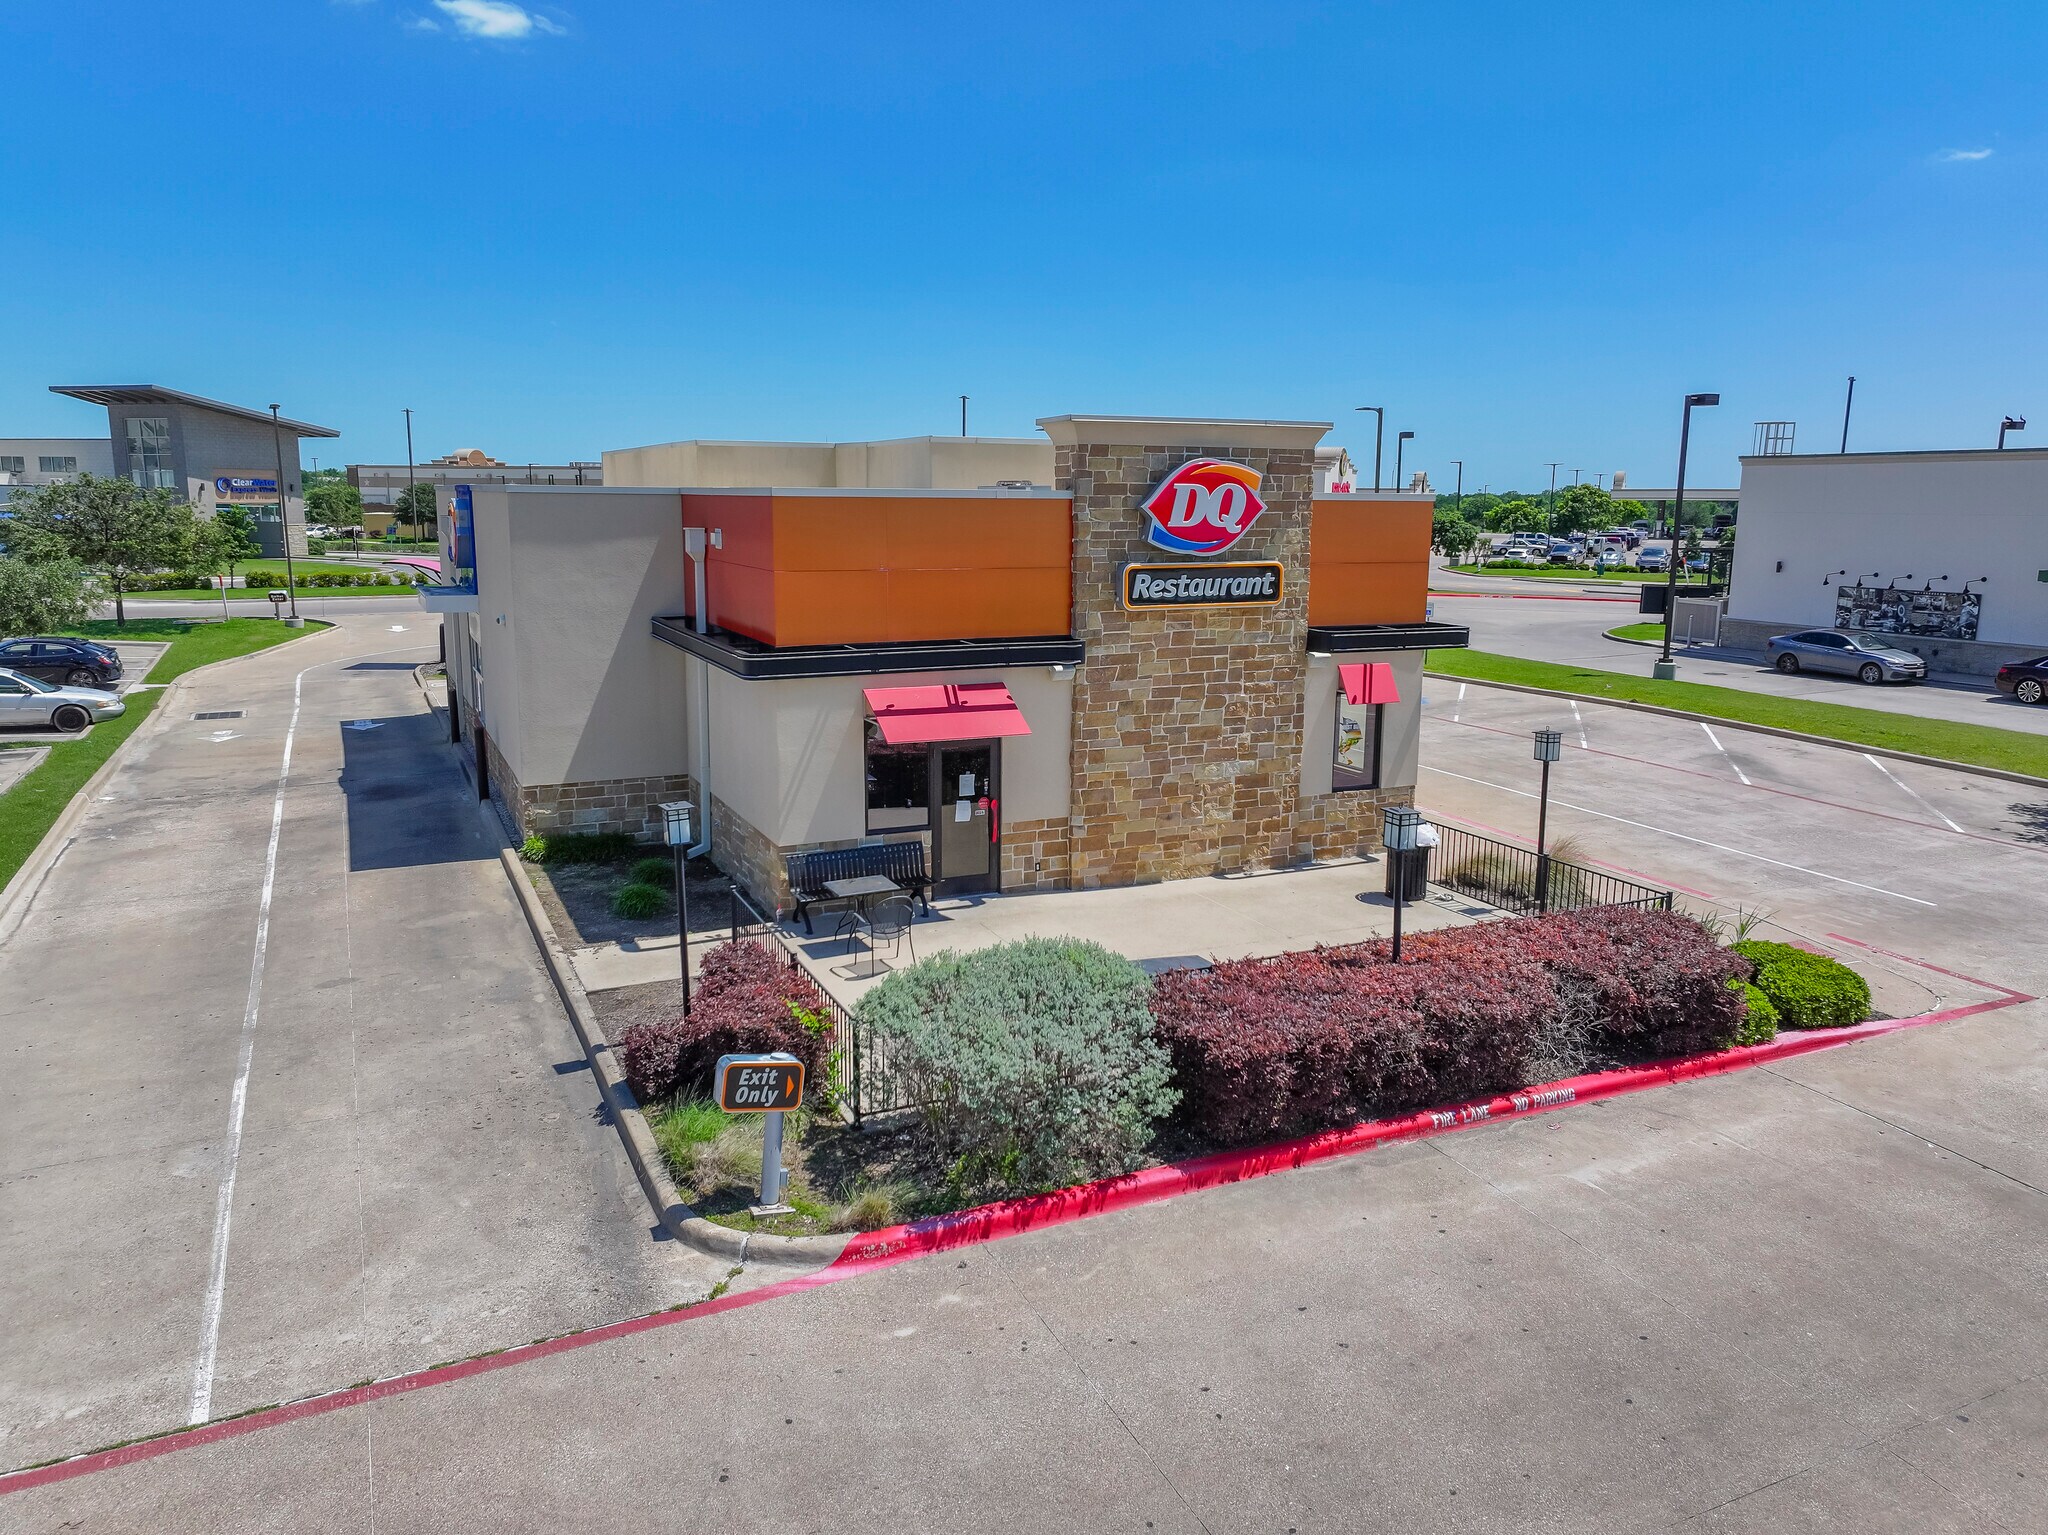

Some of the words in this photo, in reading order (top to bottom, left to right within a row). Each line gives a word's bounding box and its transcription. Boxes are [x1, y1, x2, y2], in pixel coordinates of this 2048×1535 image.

[1167, 483, 1247, 534] DQ
[1132, 572, 1276, 599] Restaurant
[739, 1067, 779, 1085] Exit
[735, 1085, 779, 1107] Only
[1431, 1111, 1458, 1129] FIRE
[1460, 1104, 1491, 1123] LANE
[1513, 1097, 1529, 1112] NO
[1532, 1088, 1576, 1109] PARKING
